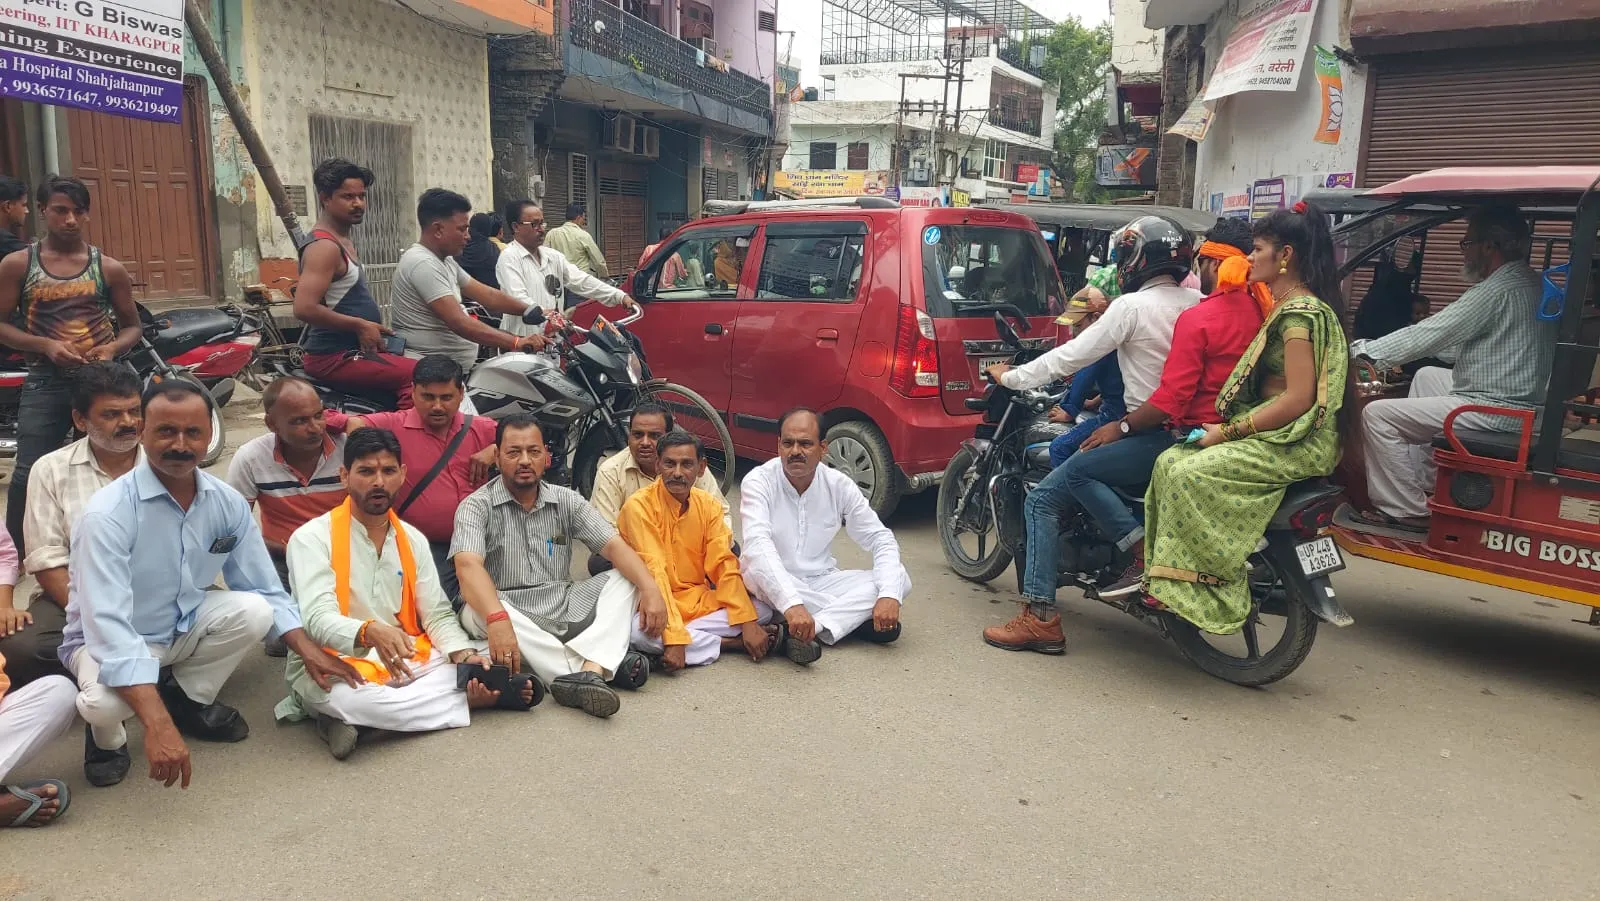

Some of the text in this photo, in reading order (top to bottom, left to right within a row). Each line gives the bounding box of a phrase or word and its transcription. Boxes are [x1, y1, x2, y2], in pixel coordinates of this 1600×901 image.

[56, 16, 80, 32] IIT
[85, 23, 181, 55] KHARAGPUR
[75, 1, 93, 17] G
[103, 6, 182, 39] Biswas
[12, 56, 72, 80] Hospital
[76, 68, 164, 97] Shahjahanpur
[56, 39, 177, 76] Experience
[13, 79, 101, 106] 9936571647,
[106, 95, 178, 117] 9936219497
[1487, 530, 1600, 572] BIG BOSS
